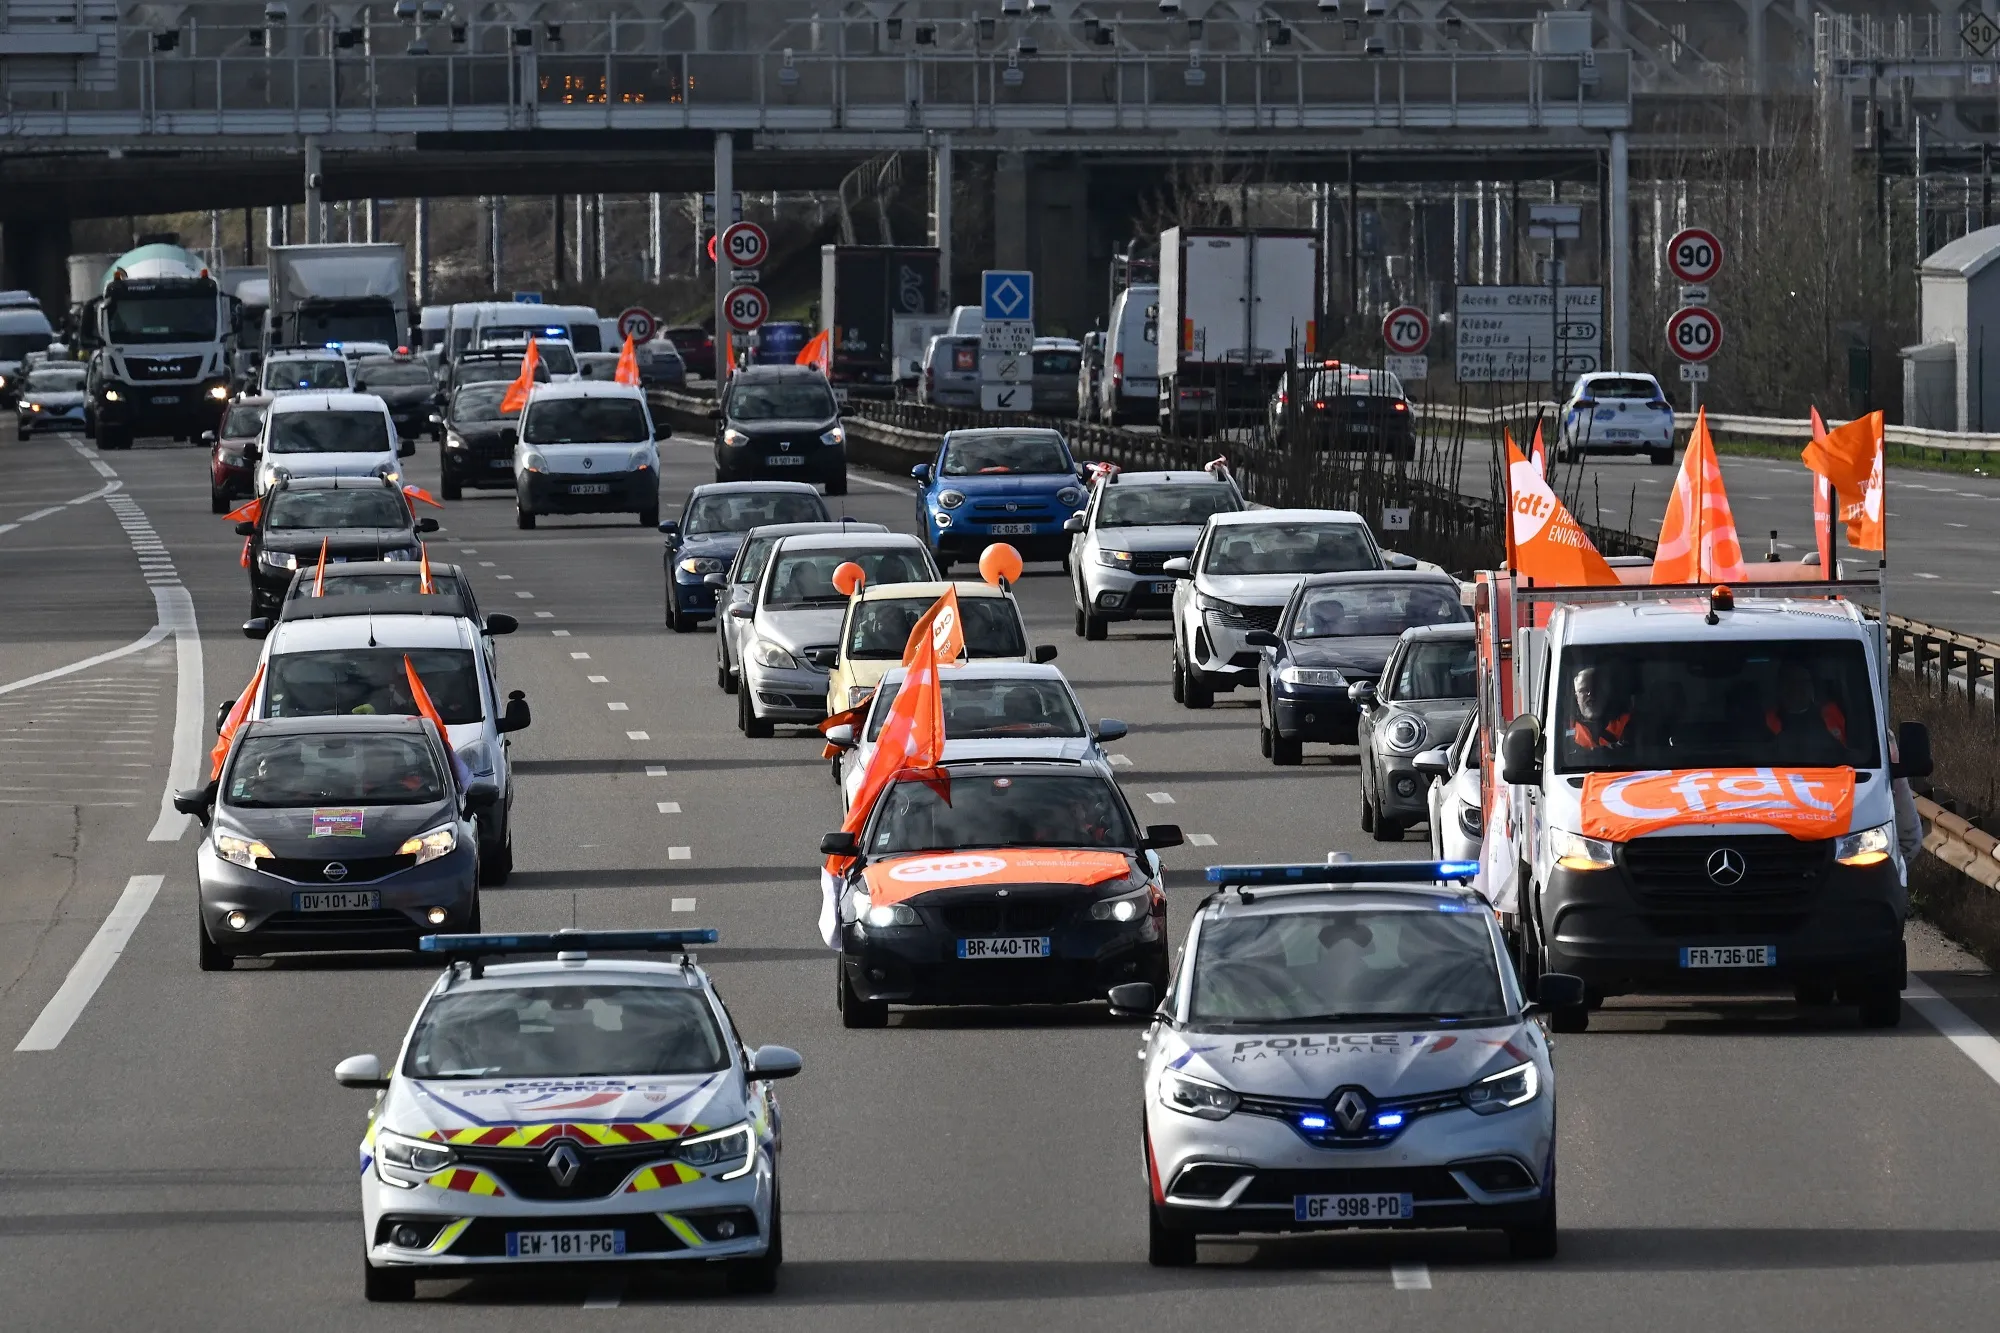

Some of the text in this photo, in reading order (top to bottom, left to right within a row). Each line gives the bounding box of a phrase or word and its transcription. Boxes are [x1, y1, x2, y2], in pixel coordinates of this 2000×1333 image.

[1971, 25, 1992, 42] 90
[732, 236, 758, 254] 90
[1678, 245, 1712, 268] 90
[733, 299, 759, 318] 80
[1565, 294, 1597, 305] VILLE
[626, 319, 647, 335] 70
[1394, 321, 1420, 341] 70
[1678, 323, 1711, 345] 80
[992, 525, 1030, 533] FC-025-JR
[303, 893, 369, 909] DV-101-JA
[967, 938, 1041, 956] BR-440-TR
[1690, 949, 1765, 965] FR-736-QE
[1233, 1034, 1400, 1054] POLICE
[1231, 1045, 1402, 1063] NATIONALE
[462, 1085, 668, 1097] NATIONALE
[504, 1080, 626, 1088] POLICE
[1308, 1196, 1399, 1217] GF-998-PD
[520, 1233, 612, 1255] EW-181-PG
